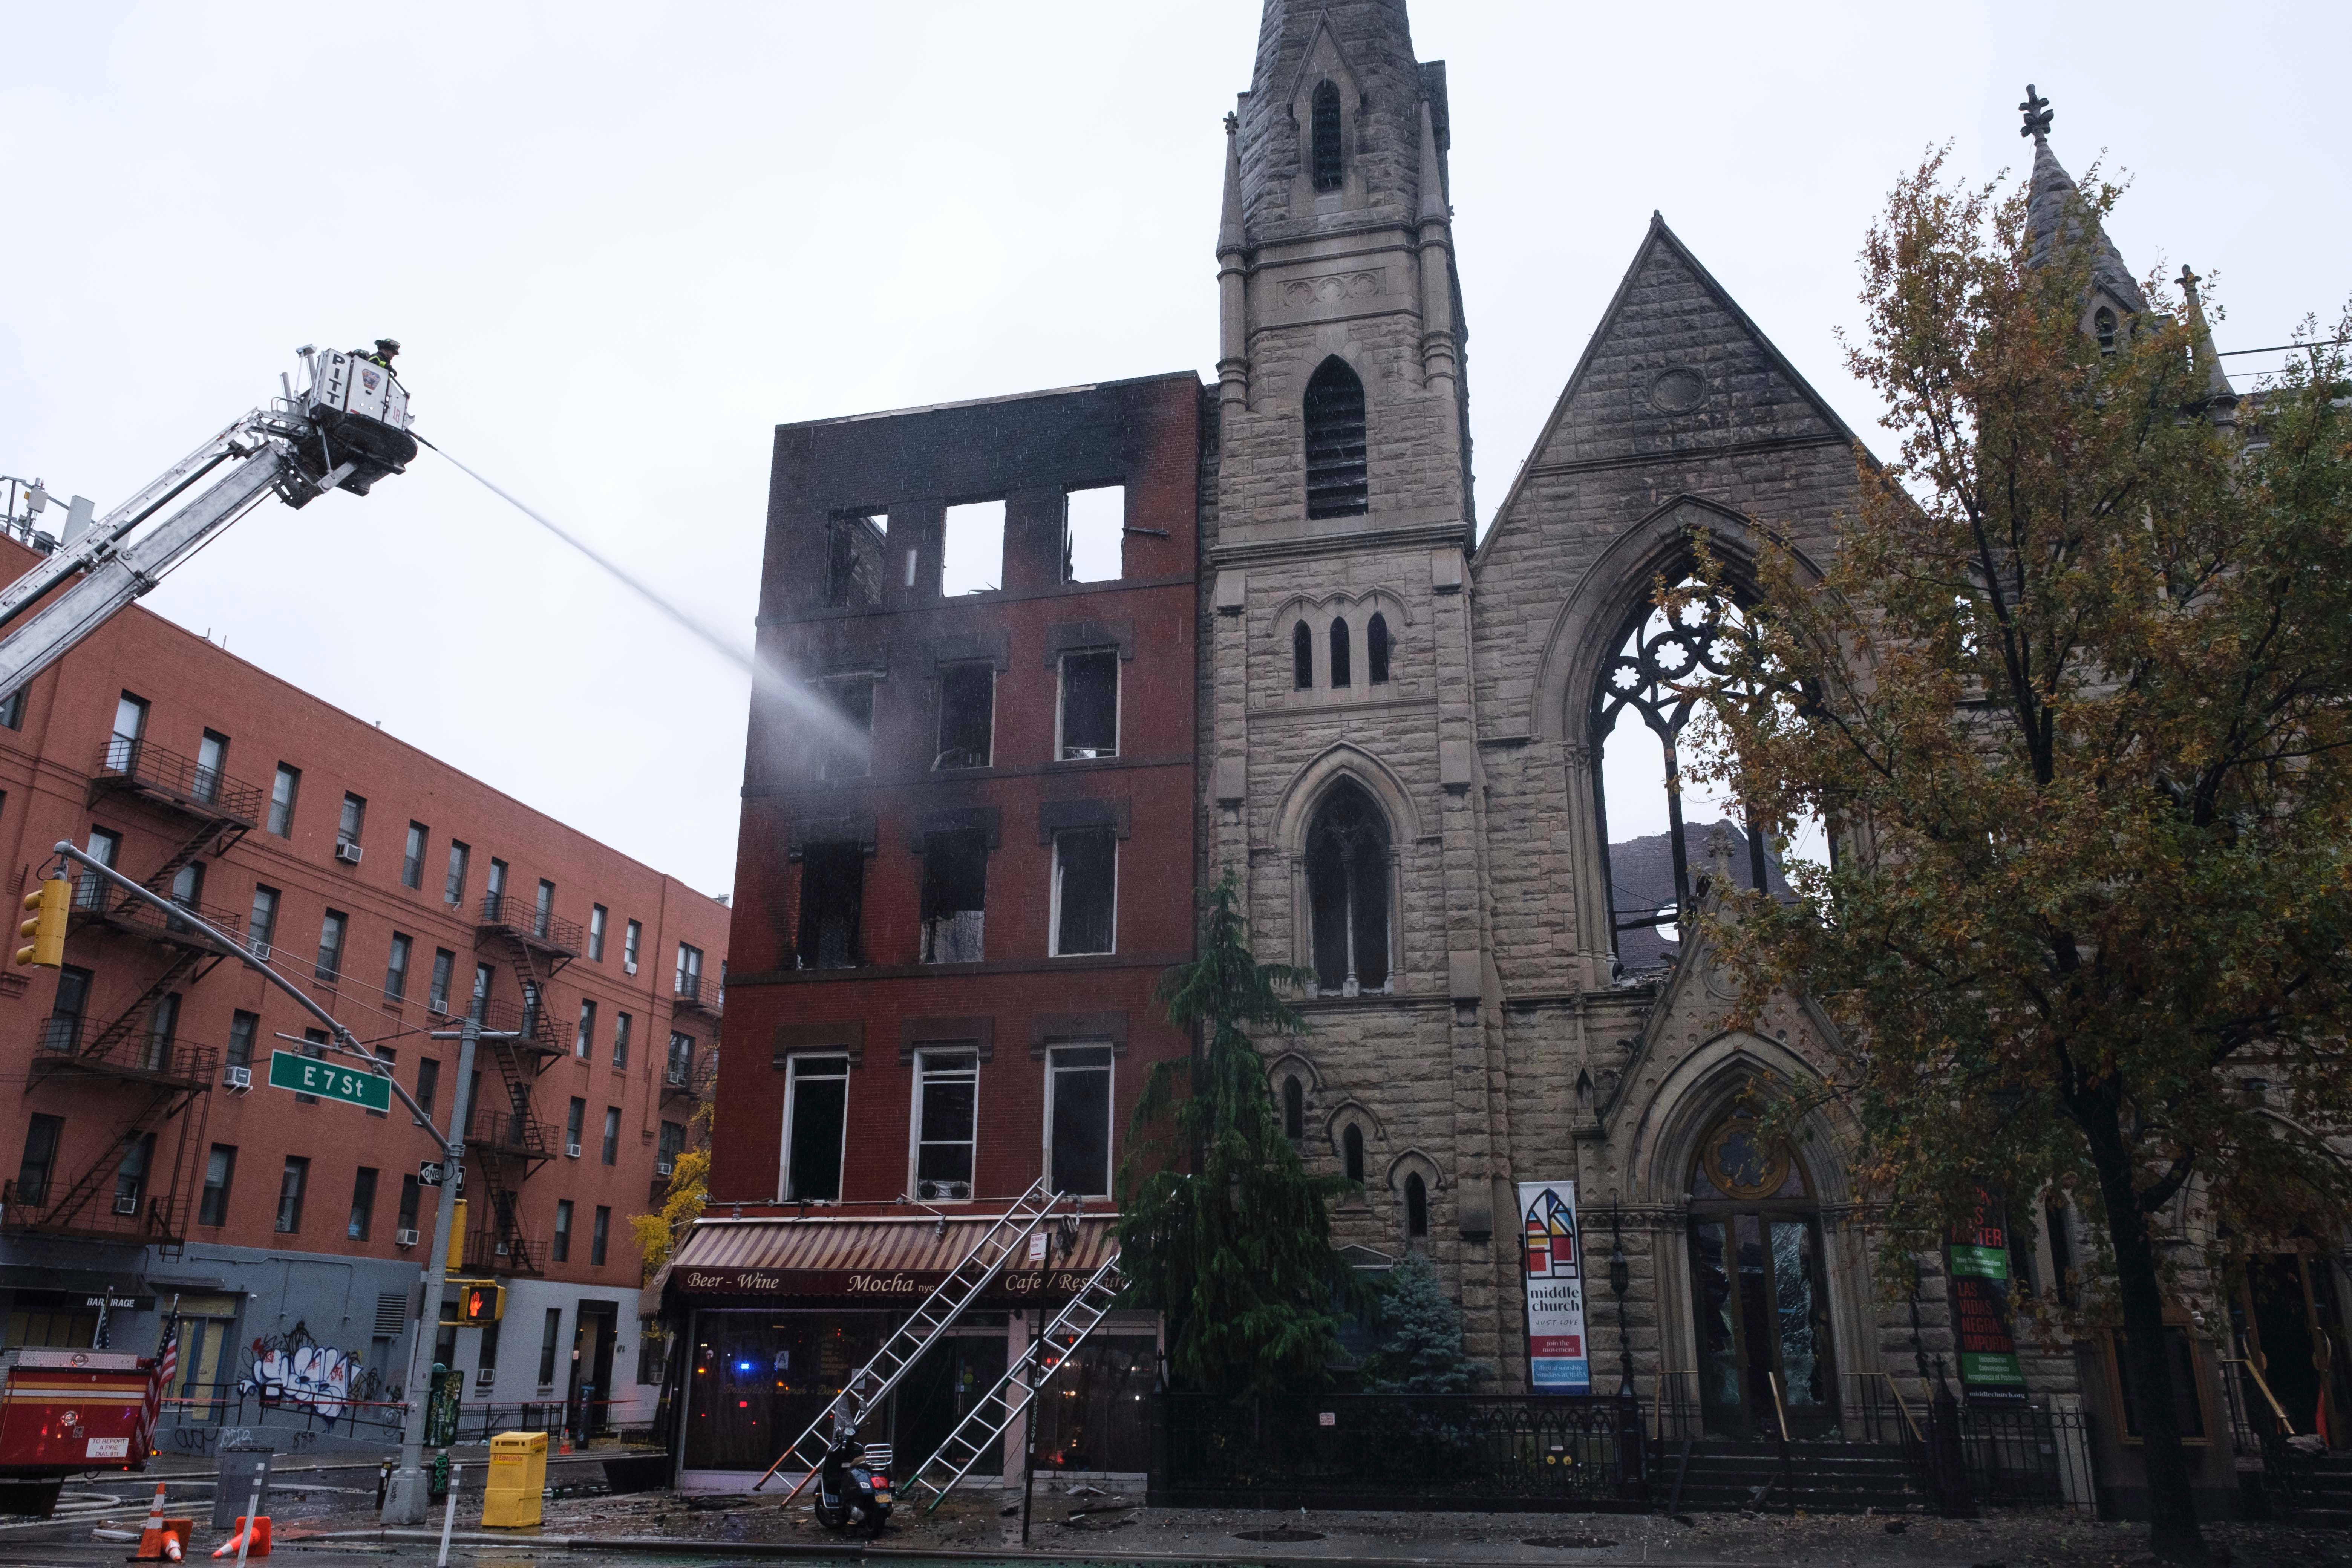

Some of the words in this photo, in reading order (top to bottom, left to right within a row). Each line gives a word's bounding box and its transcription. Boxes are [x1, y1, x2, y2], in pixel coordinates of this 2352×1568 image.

[327, 354, 346, 404] PITT
[303, 1065, 316, 1087] E
[323, 1071, 335, 1090] 7
[341, 1075, 363, 1098] St
[424, 1169, 439, 1179] ONE
[688, 1272, 724, 1287] Beer
[737, 1272, 779, 1289] Wine
[847, 1273, 914, 1292] Mocha
[918, 1284, 935, 1294] nyc
[1005, 1272, 1041, 1294] Cafe
[1531, 1286, 1579, 1298] middle
[1957, 1281, 1978, 1297] LAS
[87, 1297, 104, 1306] BAR
[106, 1298, 135, 1307] IRAGE
[1532, 1300, 1580, 1311] church
[1959, 1299, 1994, 1315] VIDAS
[778, 1354, 786, 1363] A
[1969, 1390, 2026, 1399] middlechurch.org
